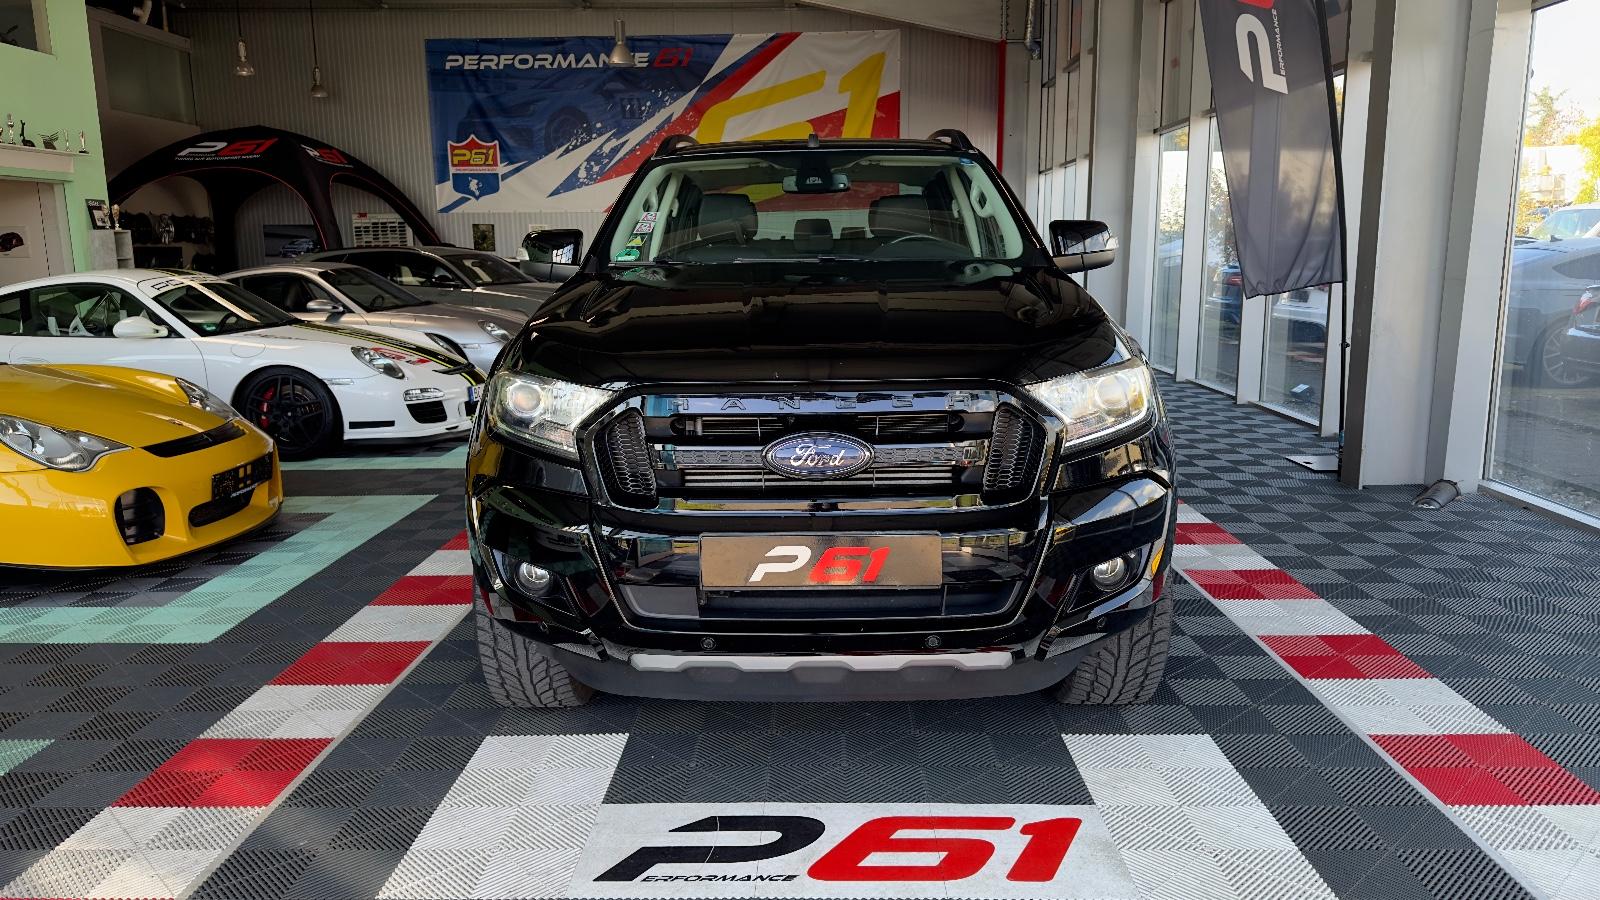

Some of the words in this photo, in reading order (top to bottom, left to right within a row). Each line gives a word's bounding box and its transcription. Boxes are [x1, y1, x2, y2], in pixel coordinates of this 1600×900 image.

[445, 52, 649, 70] PERFORMANE
[452, 148, 495, 165] P61
[789, 443, 845, 468] Ford
[748, 545, 890, 584] P61
[593, 815, 1082, 883] P61
